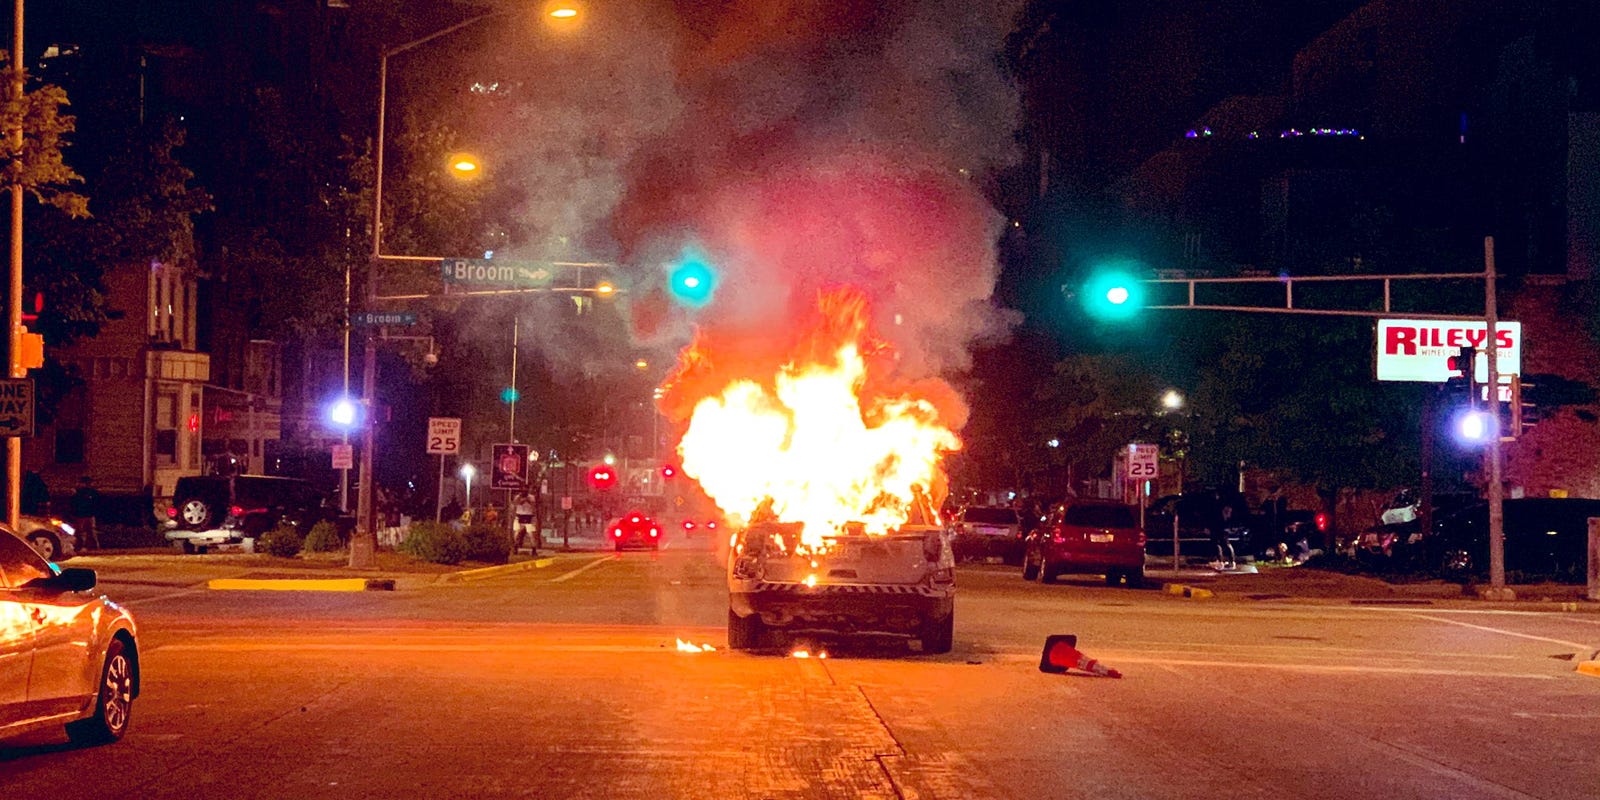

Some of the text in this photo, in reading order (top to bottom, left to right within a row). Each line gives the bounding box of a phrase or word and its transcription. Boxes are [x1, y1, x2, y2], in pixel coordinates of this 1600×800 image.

[444, 261, 514, 281] N Broom
[366, 313, 401, 324] Broom
[1385, 326, 1514, 355] RILEYS
[1421, 349, 1446, 357] WINES
[0, 384, 27, 398] NE
[430, 437, 457, 451] 25
[1131, 463, 1155, 475] 25
